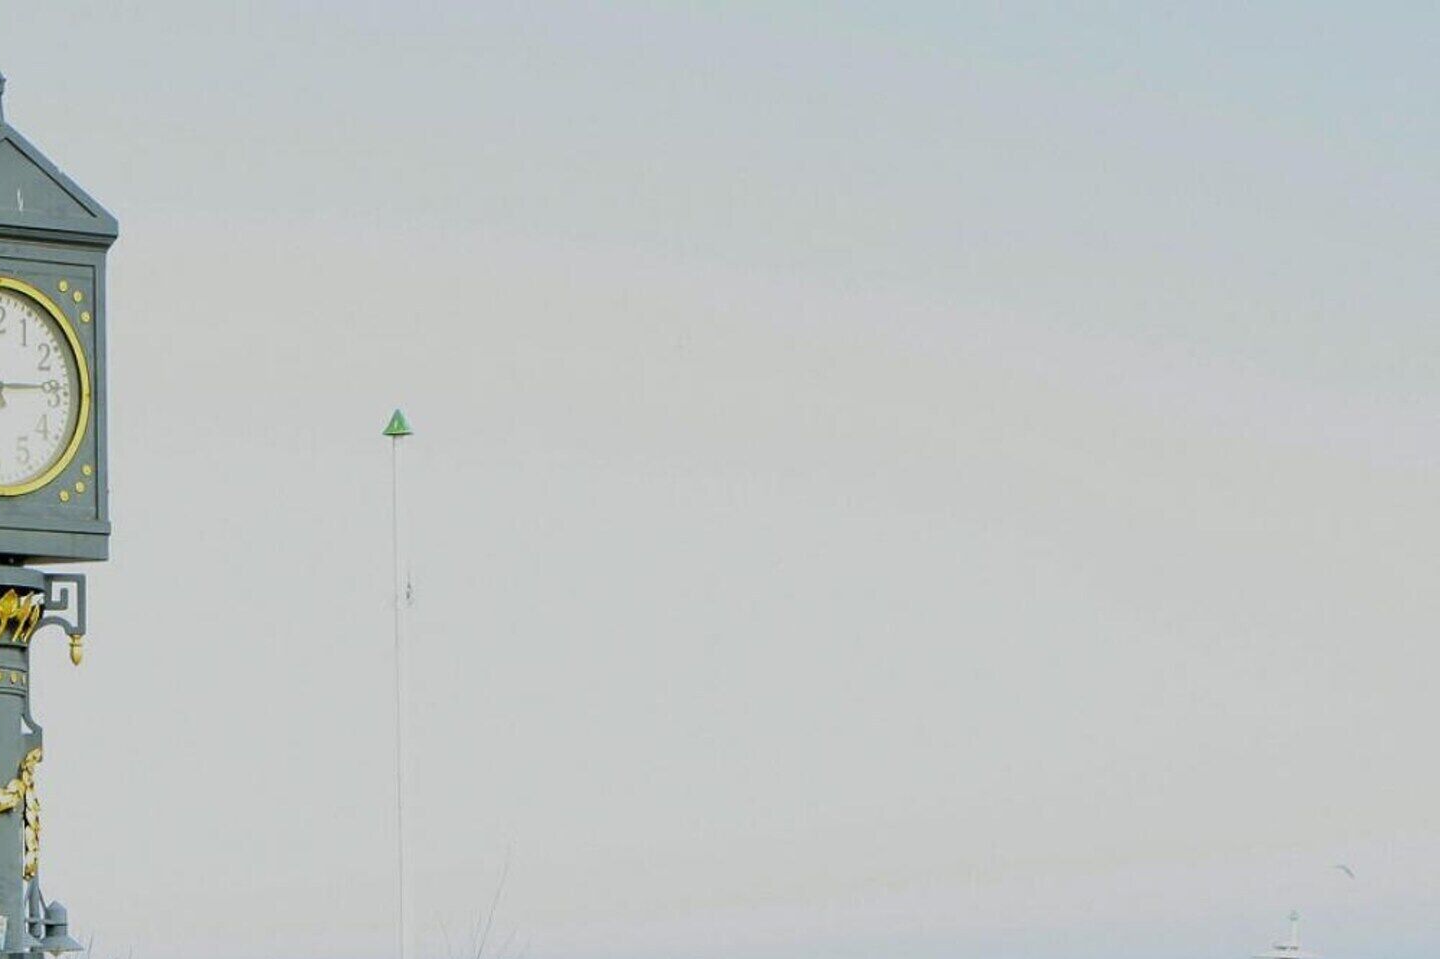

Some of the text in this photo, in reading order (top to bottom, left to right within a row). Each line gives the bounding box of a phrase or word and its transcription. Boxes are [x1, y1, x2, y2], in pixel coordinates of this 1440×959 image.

[20, 318, 28, 347] 1
[37, 343, 51, 371] 2
[35, 414, 49, 441] 4
[16, 436, 30, 464] 5
